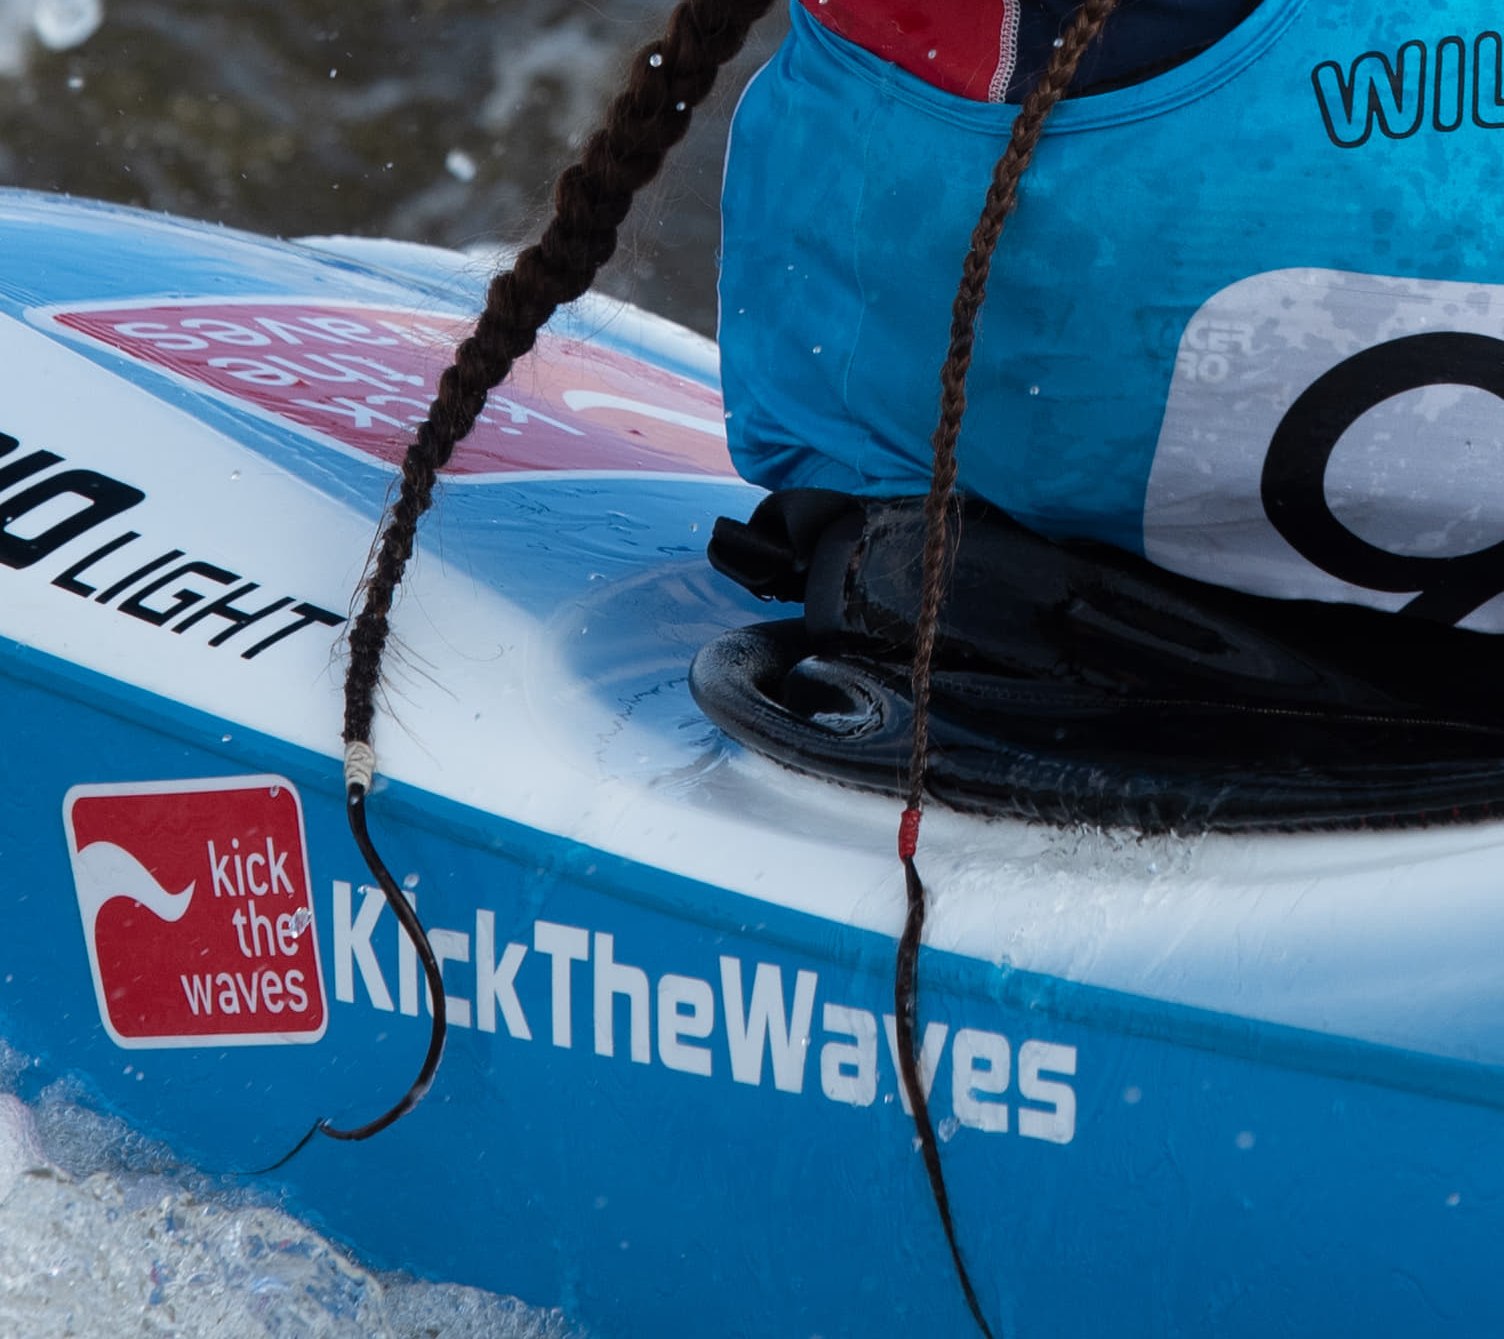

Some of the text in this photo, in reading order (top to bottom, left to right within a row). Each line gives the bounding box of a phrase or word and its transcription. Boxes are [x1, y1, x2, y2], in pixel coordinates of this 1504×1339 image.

[50, 530, 348, 660] LIGHT
[206, 836, 295, 898] kick
[231, 899, 300, 958] the
[179, 969, 309, 1016] waves
[332, 879, 1078, 1145] KickTheWaves
